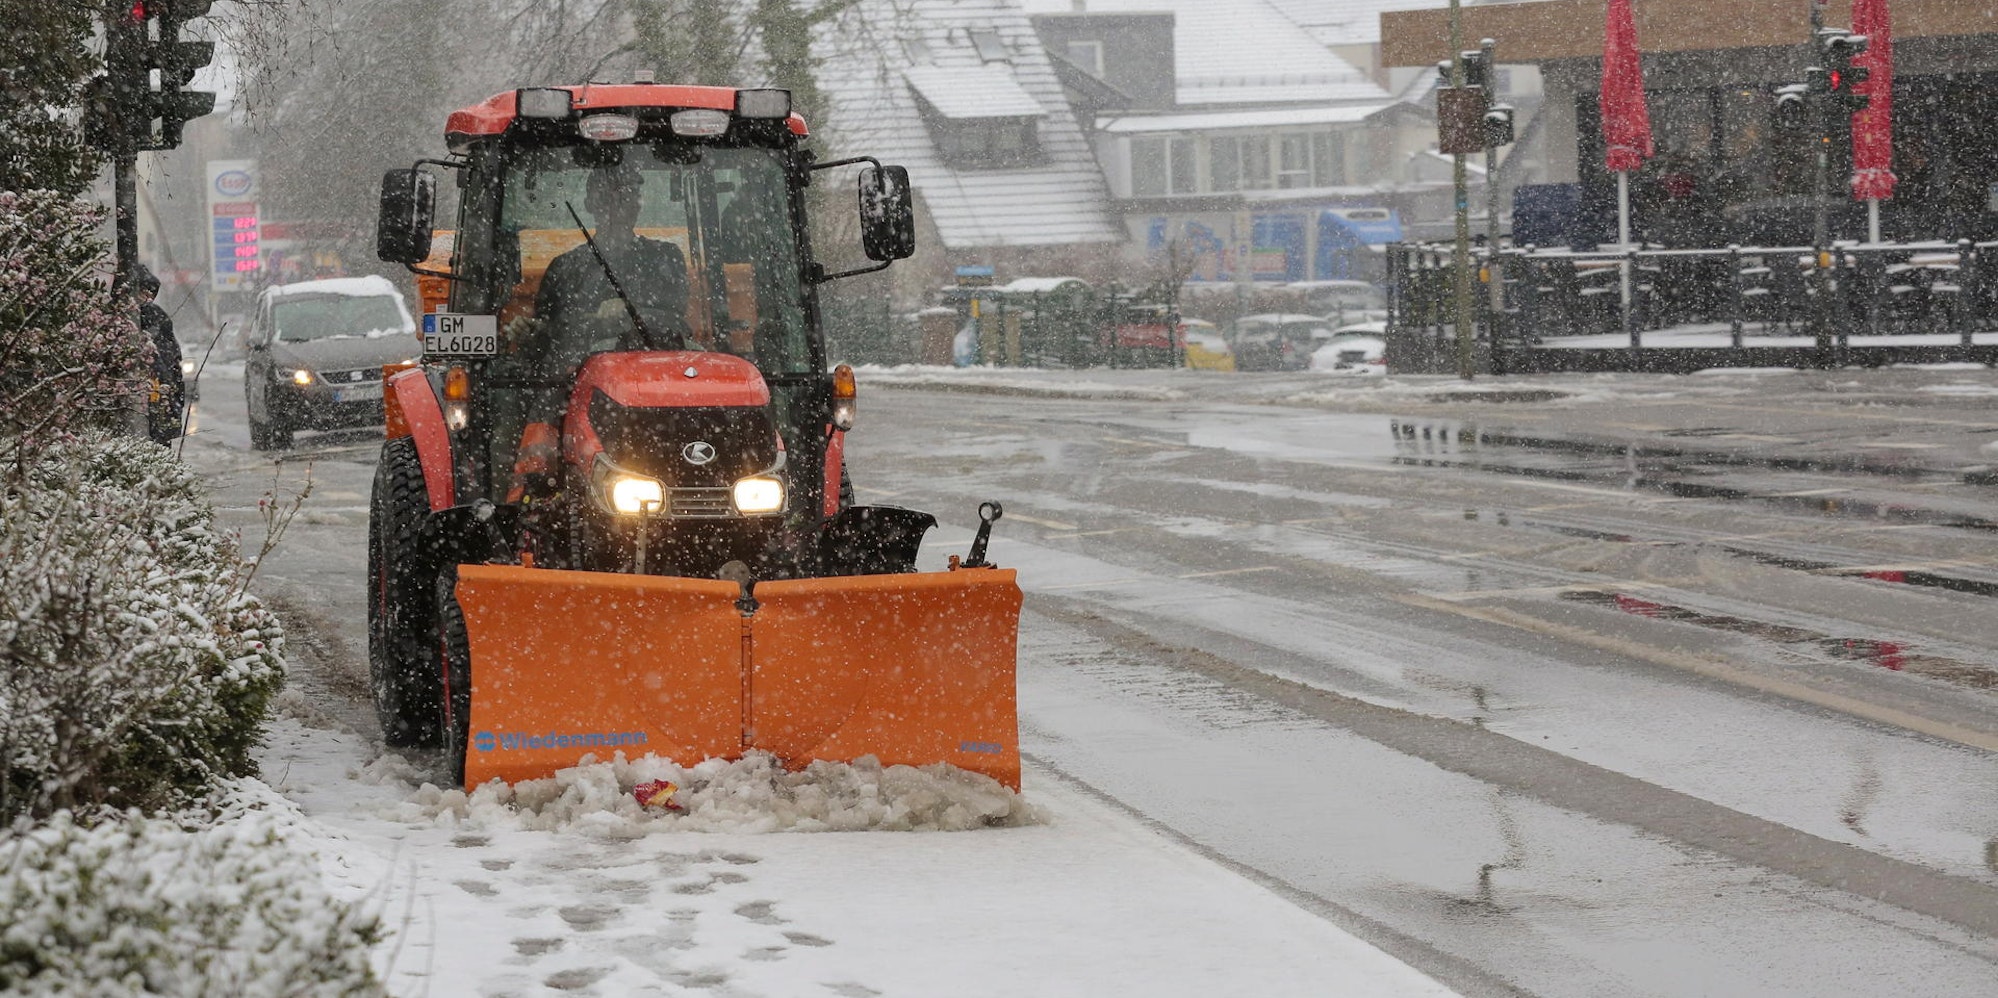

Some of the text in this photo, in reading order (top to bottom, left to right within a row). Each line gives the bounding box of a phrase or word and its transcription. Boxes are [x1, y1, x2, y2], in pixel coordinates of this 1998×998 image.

[440, 317, 464, 333] GM
[425, 336, 495, 352] EL6028
[499, 731, 648, 750] Wiedenmann
